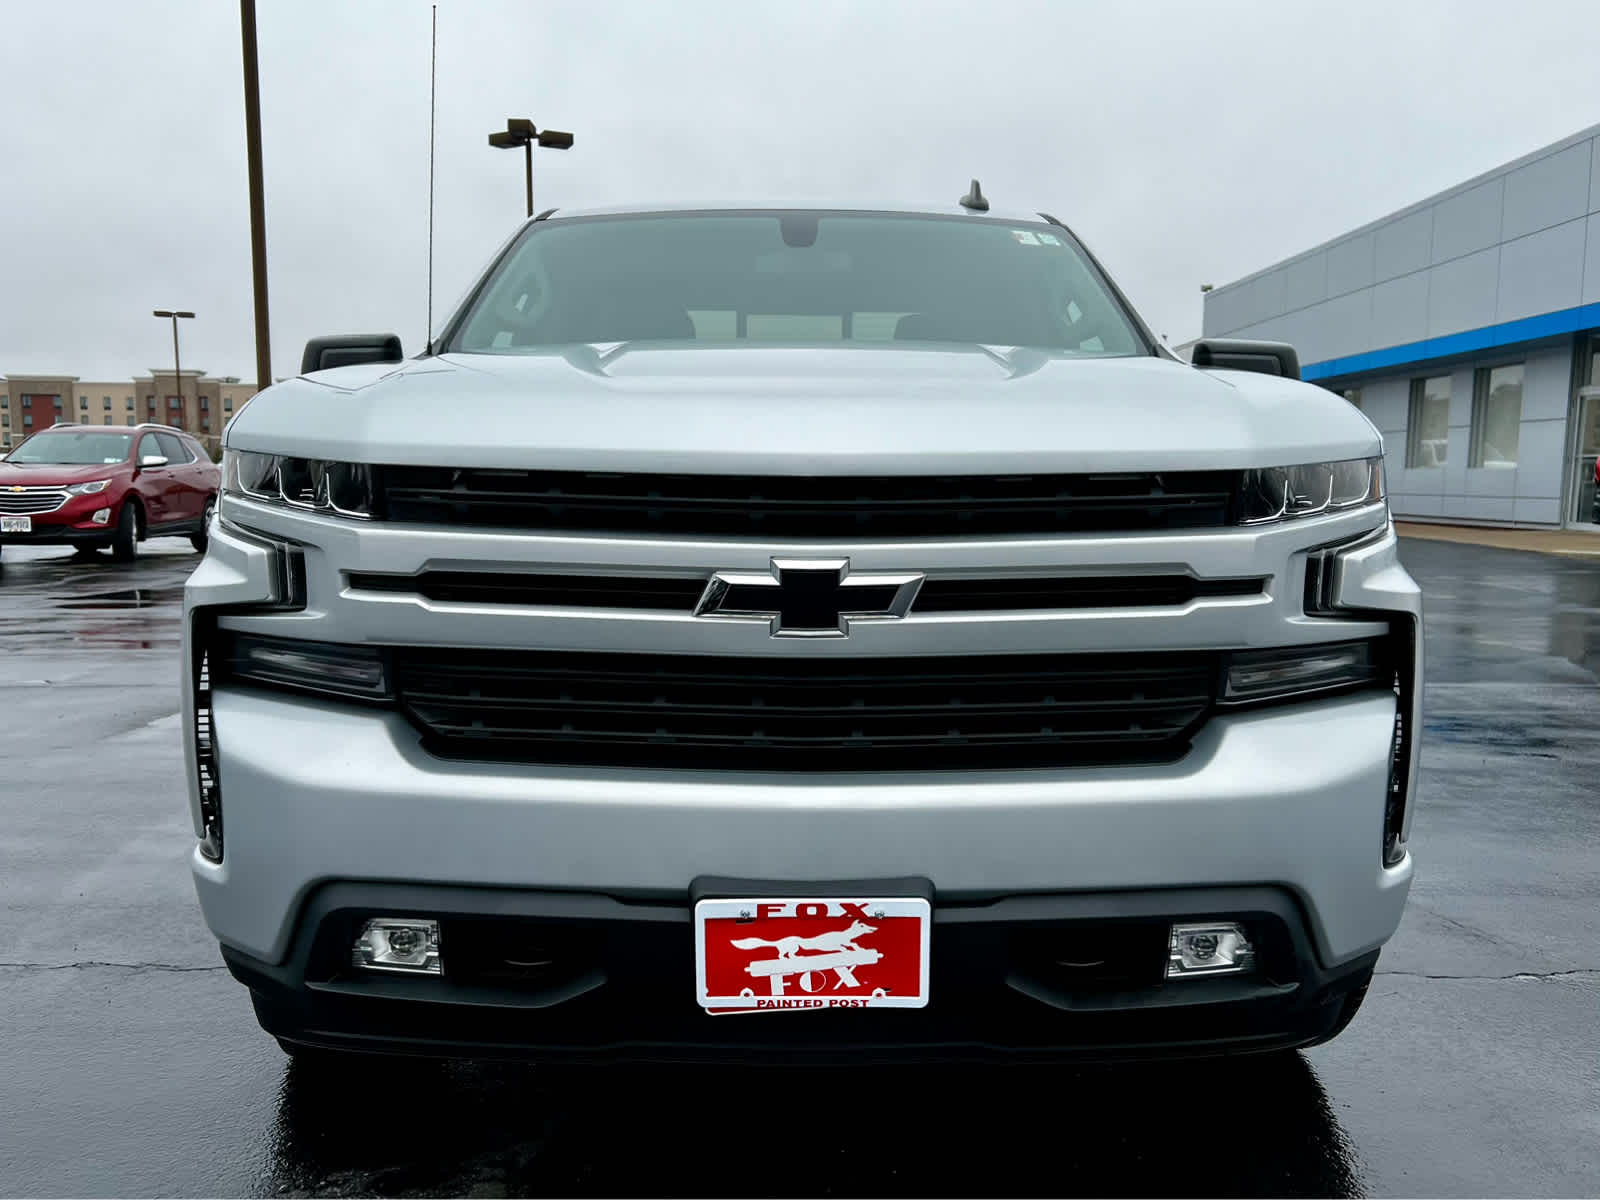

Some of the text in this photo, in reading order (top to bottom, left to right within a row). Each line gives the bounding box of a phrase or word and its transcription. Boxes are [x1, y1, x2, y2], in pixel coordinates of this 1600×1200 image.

[756, 903, 870, 918] FOX
[769, 964, 861, 996] FOX
[756, 999, 870, 1008] PAINTED POST
